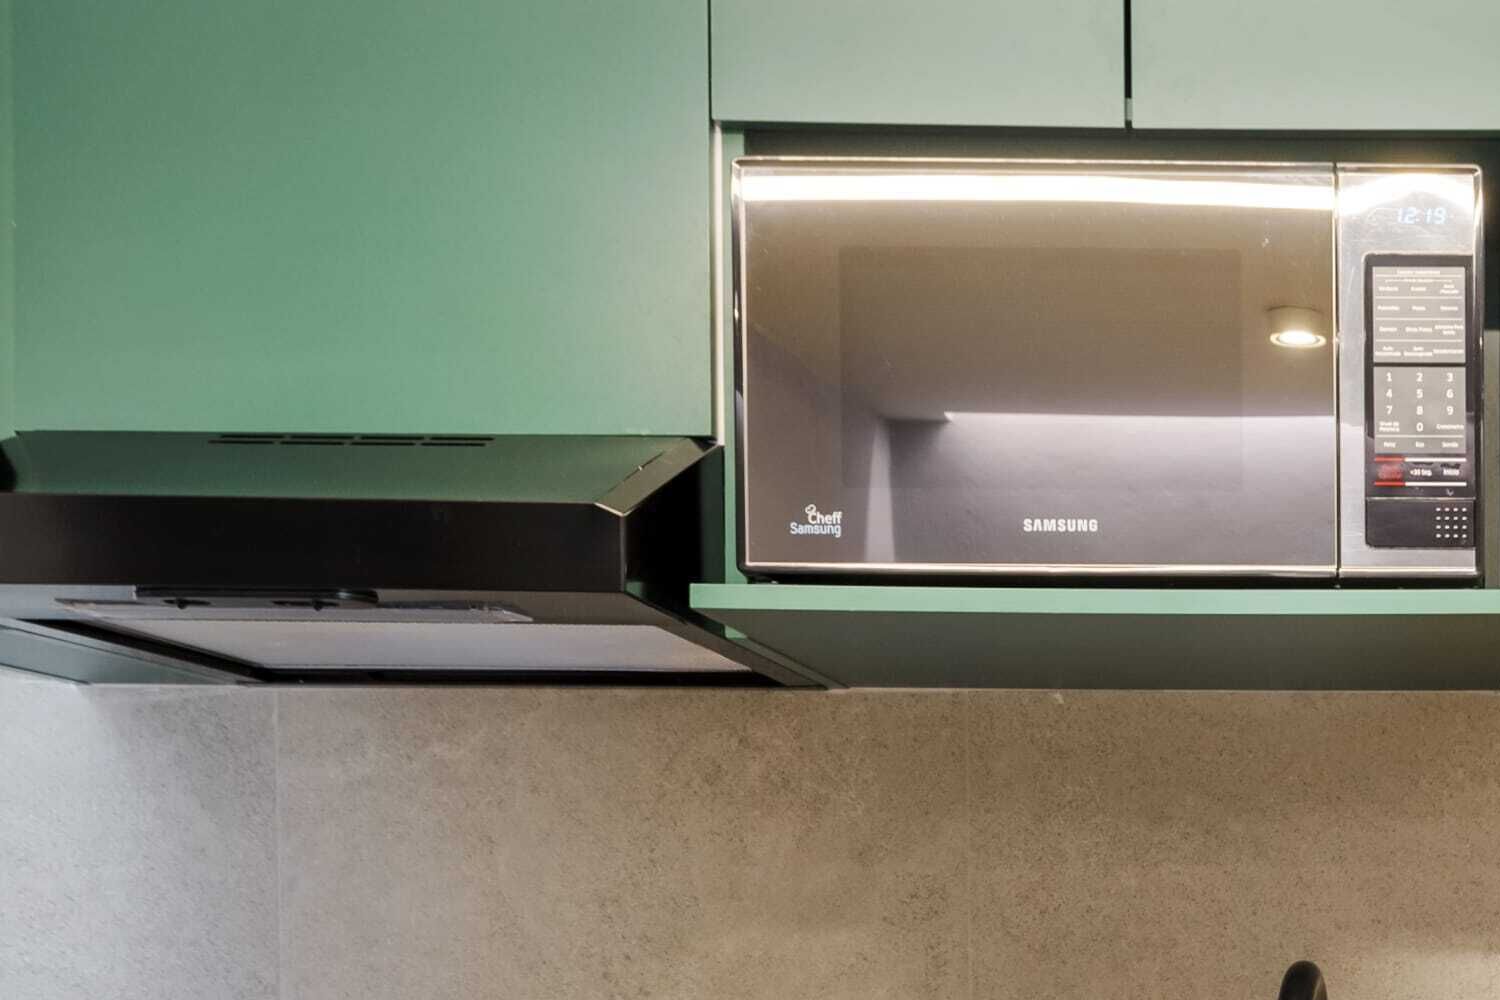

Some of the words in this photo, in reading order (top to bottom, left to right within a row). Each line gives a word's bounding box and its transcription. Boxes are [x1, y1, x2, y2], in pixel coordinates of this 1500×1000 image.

[1386, 372, 1392, 382] 1
[1416, 372, 1423, 382] 2
[1446, 372, 1453, 382] 3
[1386, 389, 1393, 399] 4
[1416, 389, 1423, 399] 5
[1446, 389, 1453, 399] 6
[1386, 406, 1393, 415] 7
[1416, 406, 1423, 416] 8
[1446, 406, 1453, 416] 9
[1416, 422, 1423, 432] 0
[808, 511, 842, 524] Cheff
[790, 521, 842, 538] Samsung
[1023, 518, 1099, 532] SAMSUNG
